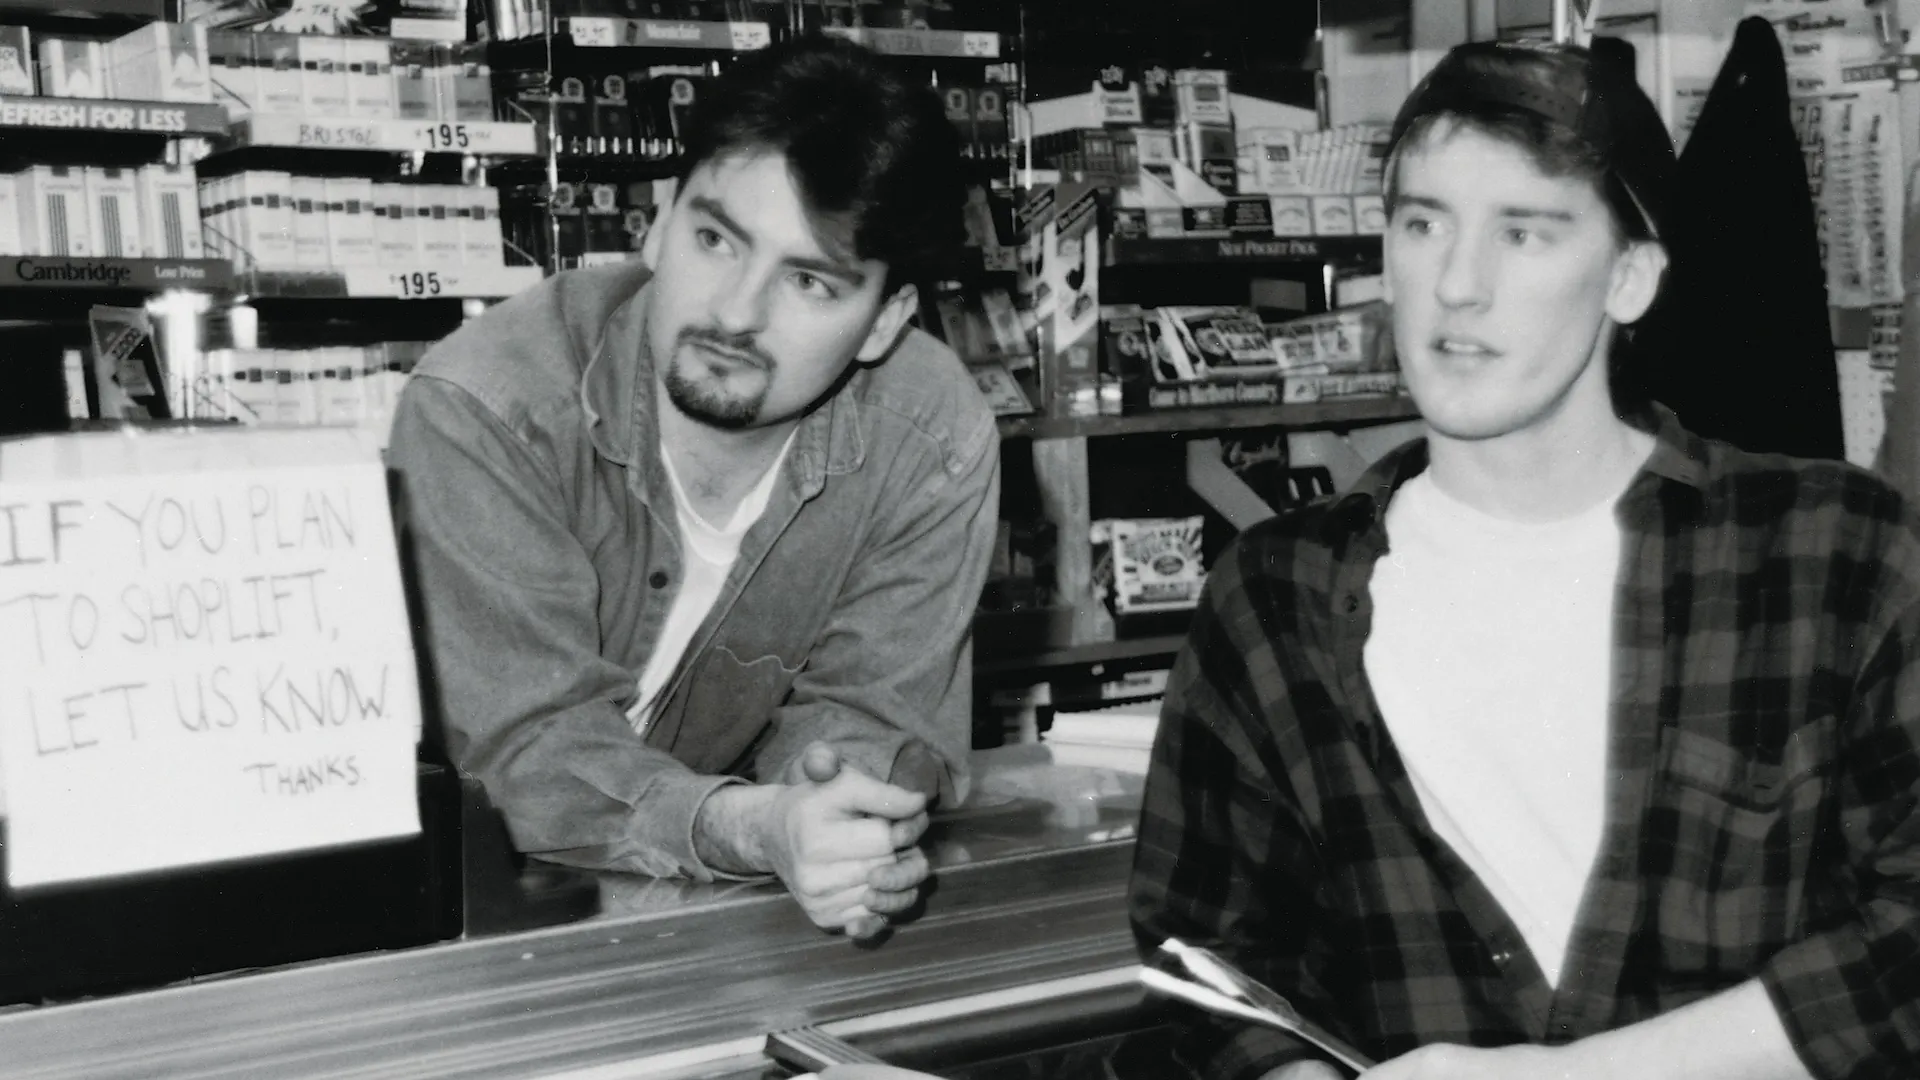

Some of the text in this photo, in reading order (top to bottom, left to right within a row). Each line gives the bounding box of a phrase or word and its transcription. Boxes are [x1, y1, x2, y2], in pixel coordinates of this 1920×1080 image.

[0, 103, 187, 132] EFRESH FOR LESS
[299, 123, 376, 145] BRISTOL
[16, 259, 206, 285] Cambridge Low Price
[0, 484, 357, 567] IF YOU PLAN
[0, 568, 340, 666] TO SHOPLIFT,
[26, 682, 149, 758] LET
[171, 665, 240, 733] US
